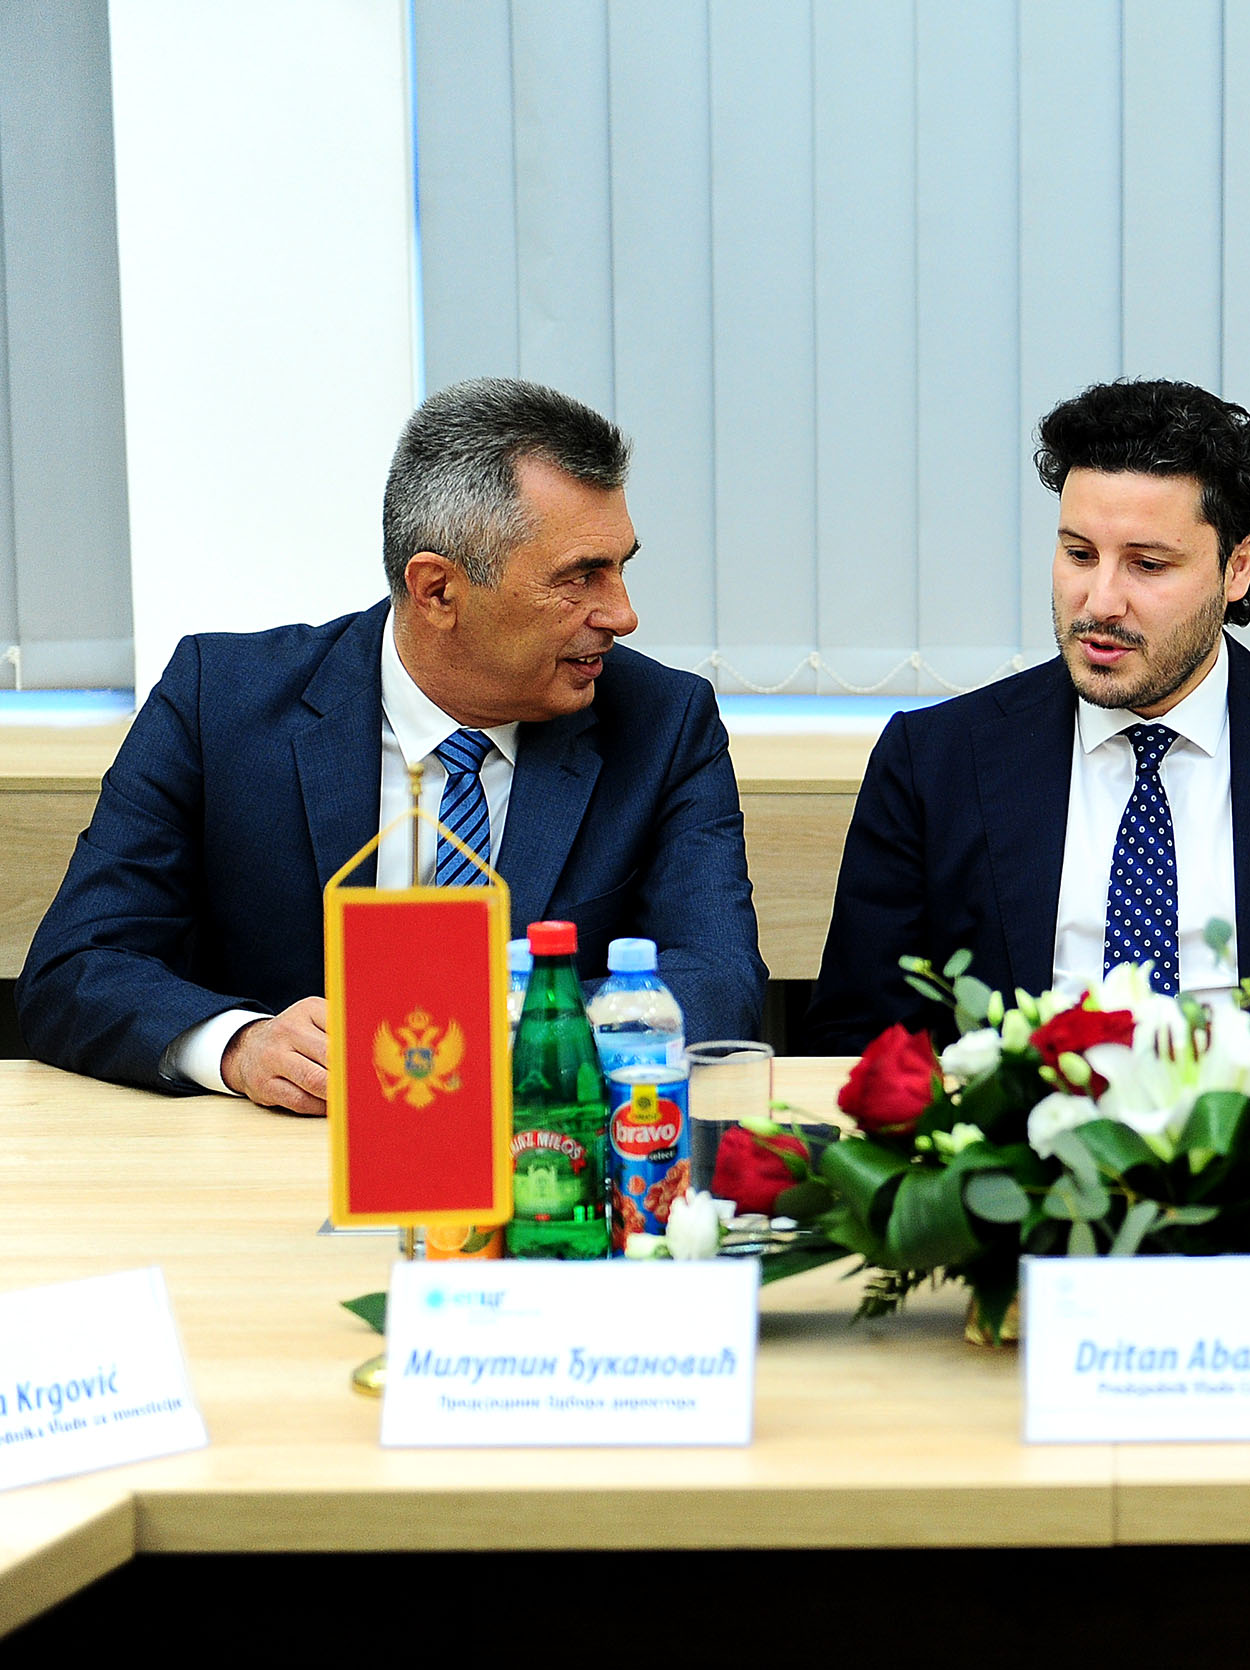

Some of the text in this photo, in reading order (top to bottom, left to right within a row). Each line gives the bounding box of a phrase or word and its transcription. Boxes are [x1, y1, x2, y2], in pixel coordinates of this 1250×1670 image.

[616, 1120, 677, 1144] bravo
[404, 1348, 558, 1384] Милутин
[1074, 1339, 1179, 1374] Dritan
[16, 1363, 119, 1416] Krgović
